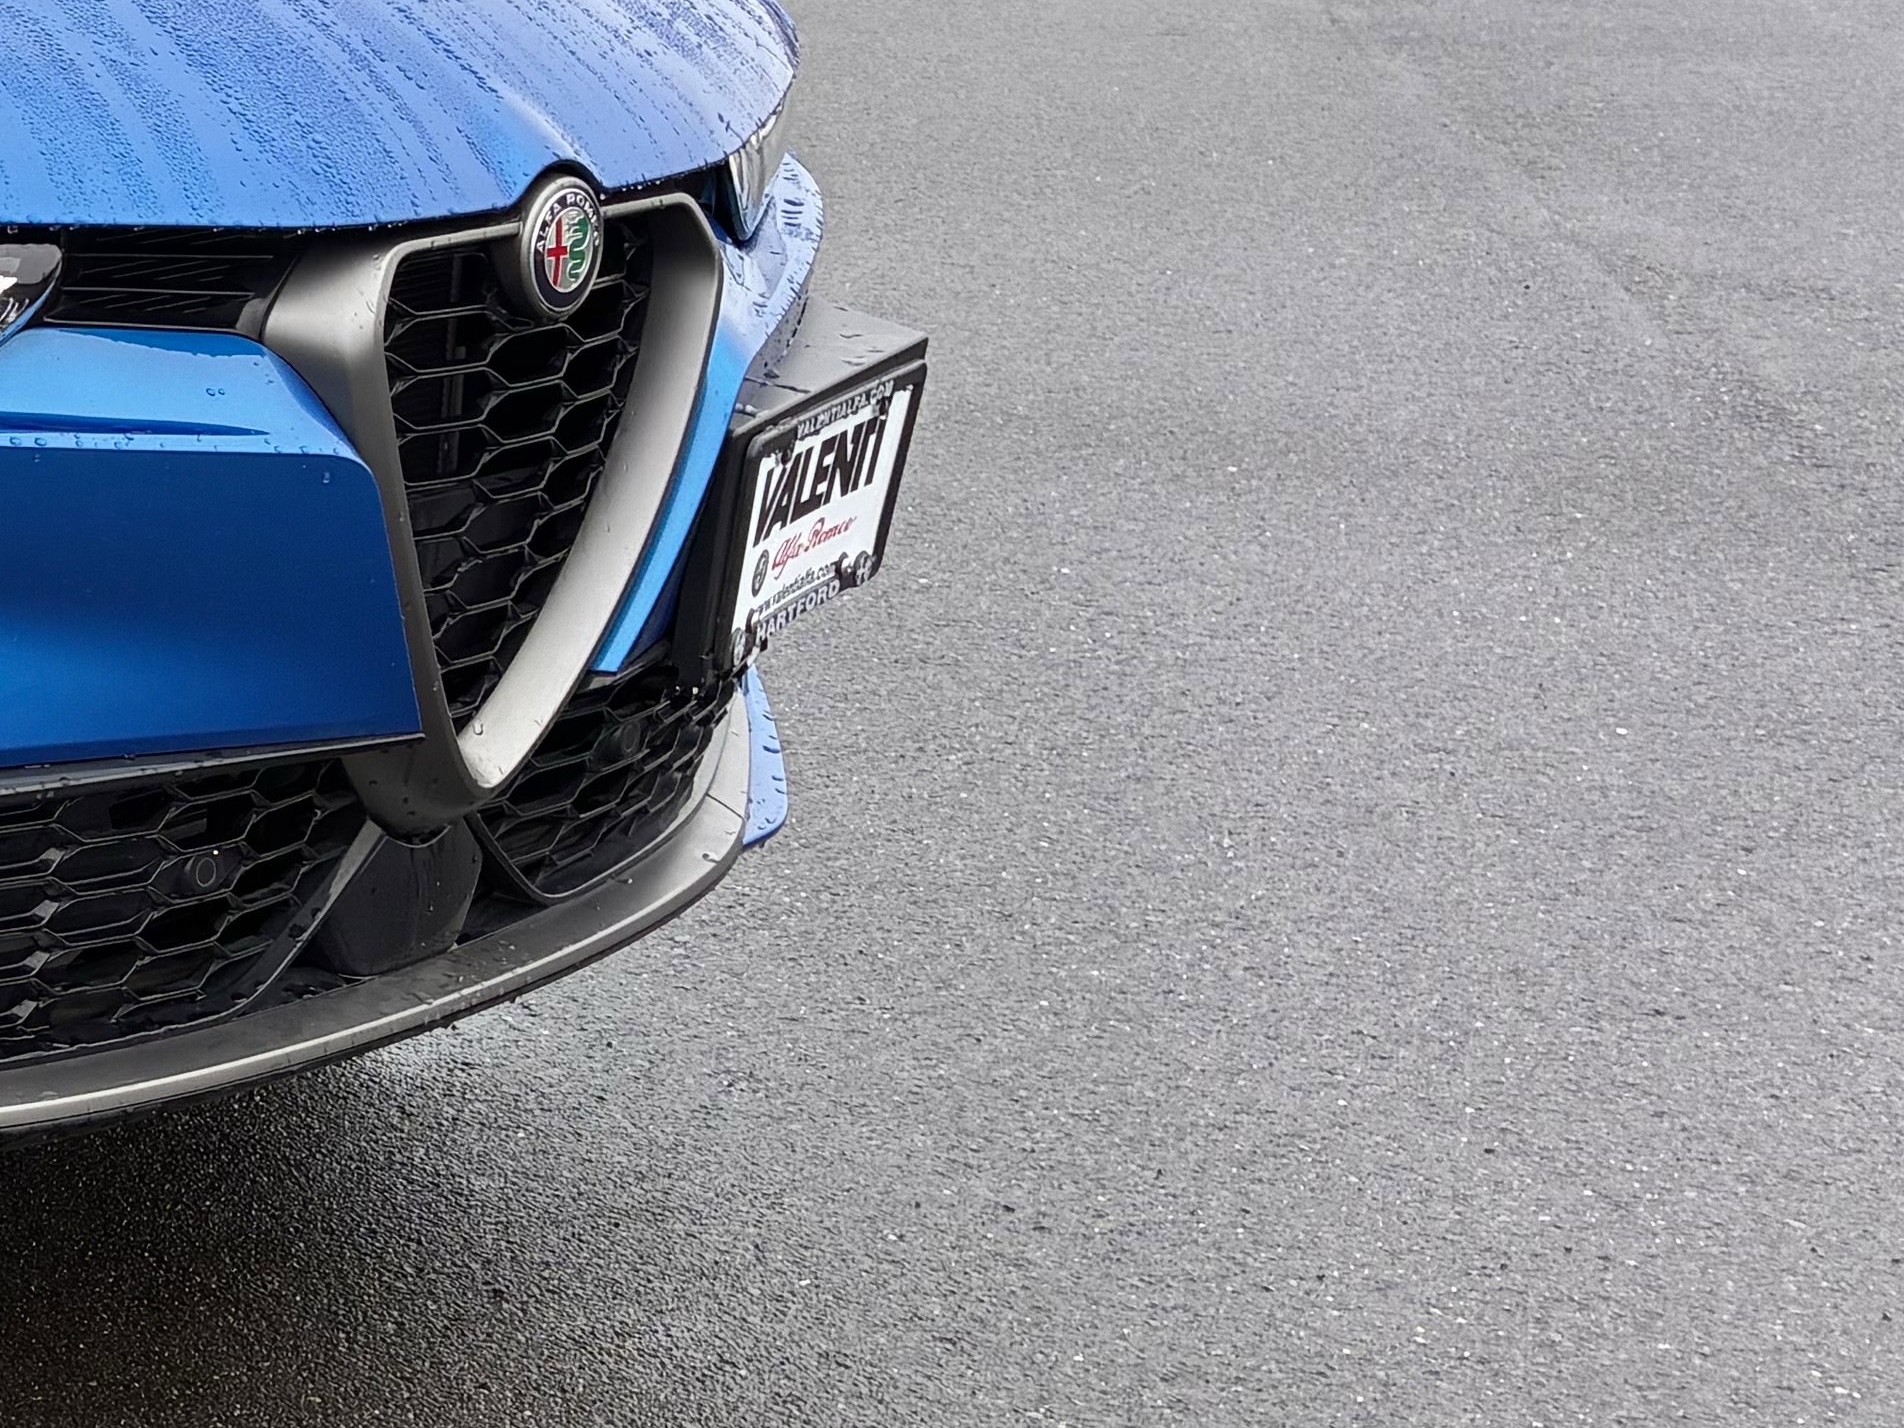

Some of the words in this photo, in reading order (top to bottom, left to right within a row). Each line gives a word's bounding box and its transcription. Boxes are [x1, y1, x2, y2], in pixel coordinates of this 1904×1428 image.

[536, 203, 561, 252] ALFA
[753, 415, 888, 548] VALENTI
[771, 532, 804, 581] Alfa
[803, 516, 857, 552] Romeo
[754, 579, 841, 646] HARTFORD
